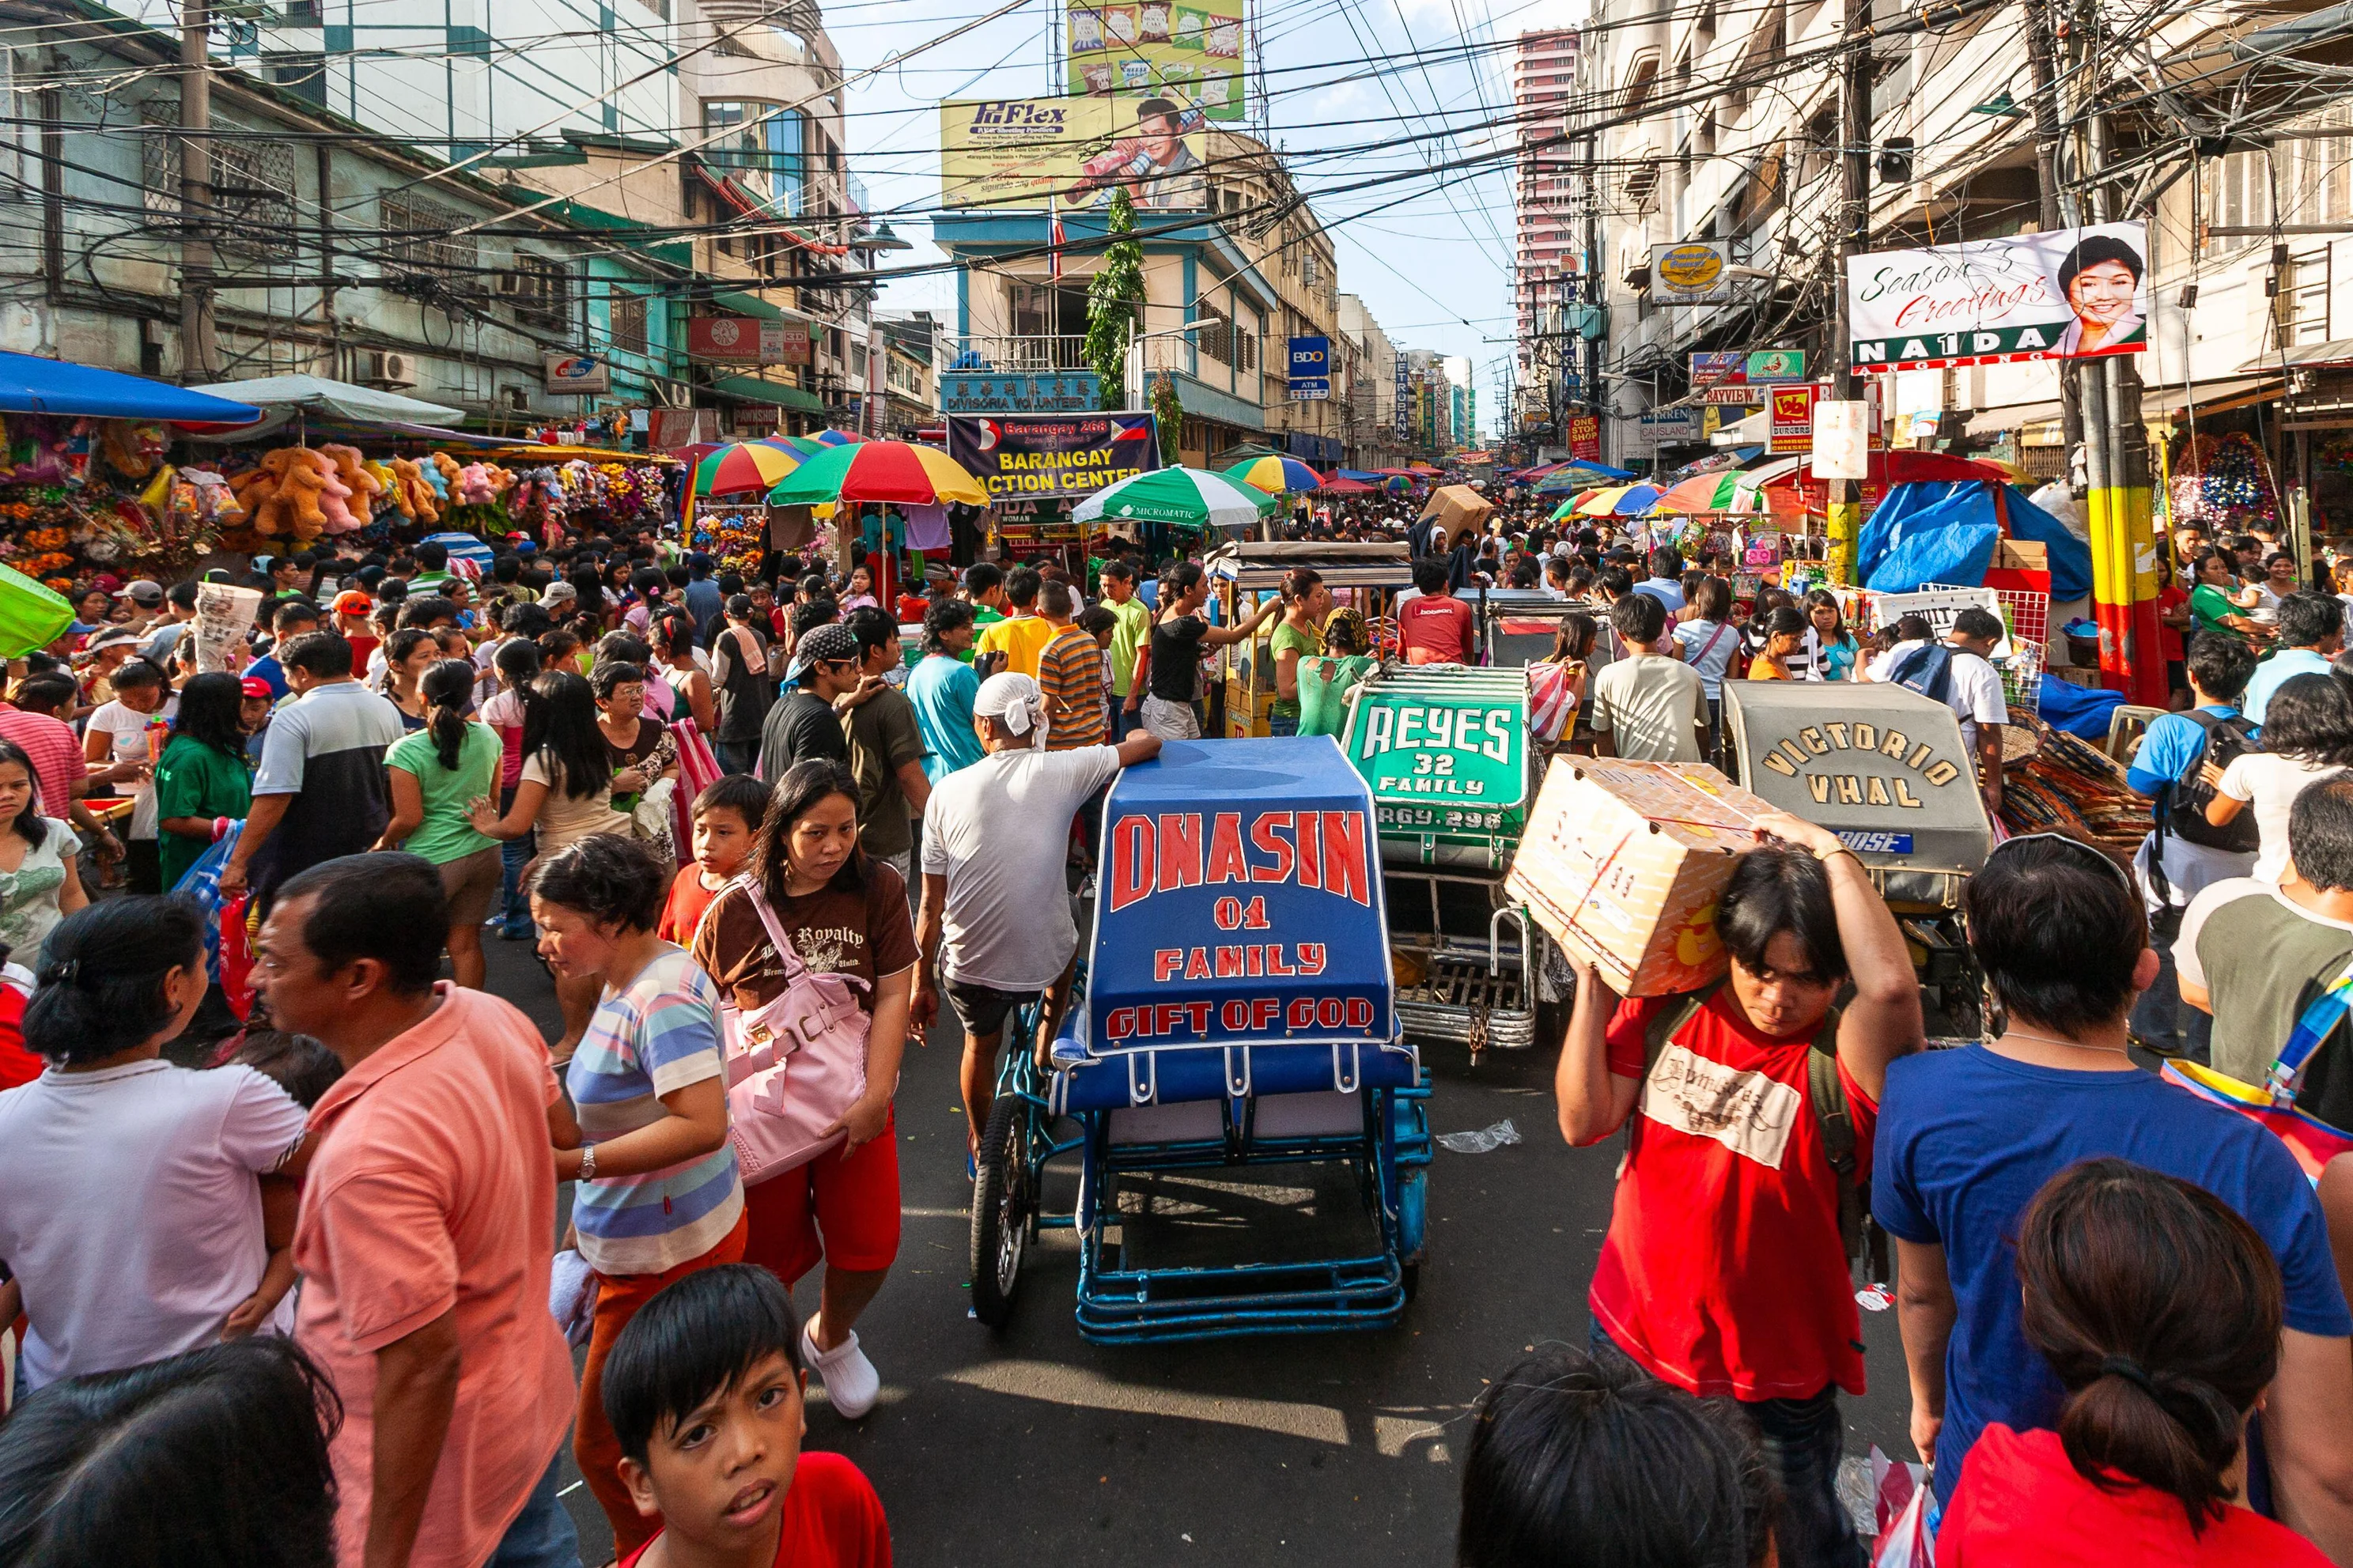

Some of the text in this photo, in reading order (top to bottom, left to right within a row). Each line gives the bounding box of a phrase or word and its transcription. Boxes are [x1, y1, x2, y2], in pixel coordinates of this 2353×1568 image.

[1895, 276, 2046, 328] Greetings
[1293, 351, 1324, 363] BDO
[1857, 353, 2045, 377] ANGPING
[948, 397, 1009, 410] DIVISORIA
[1014, 396, 1086, 410] VOLUNTEER
[1397, 353, 1409, 442] METROBANK
[1706, 388, 1756, 403] BAYVIEW
[736, 410, 777, 422] PAWNSHOP
[1574, 418, 1594, 426] ONE
[1004, 420, 1107, 436] Barangay 268
[1572, 425, 1596, 434] STOP
[1572, 433, 1597, 441] SHOP
[999, 448, 1114, 470] BARANGAY
[975, 474, 1055, 493] ACTION
[1136, 507, 1195, 520] MICROMATIC
[1362, 705, 1511, 765] REYES
[1413, 753, 1455, 776] 32
[1761, 722, 1961, 787] VICTORIO
[1379, 776, 1485, 795] FAMILY
[1805, 773, 1924, 808] VHAL
[1213, 895, 1271, 931] 01
[797, 926, 864, 949] Royalty
[1154, 943, 1326, 981] FAMILY
[1107, 997, 1374, 1041] GIFT OF GOD
